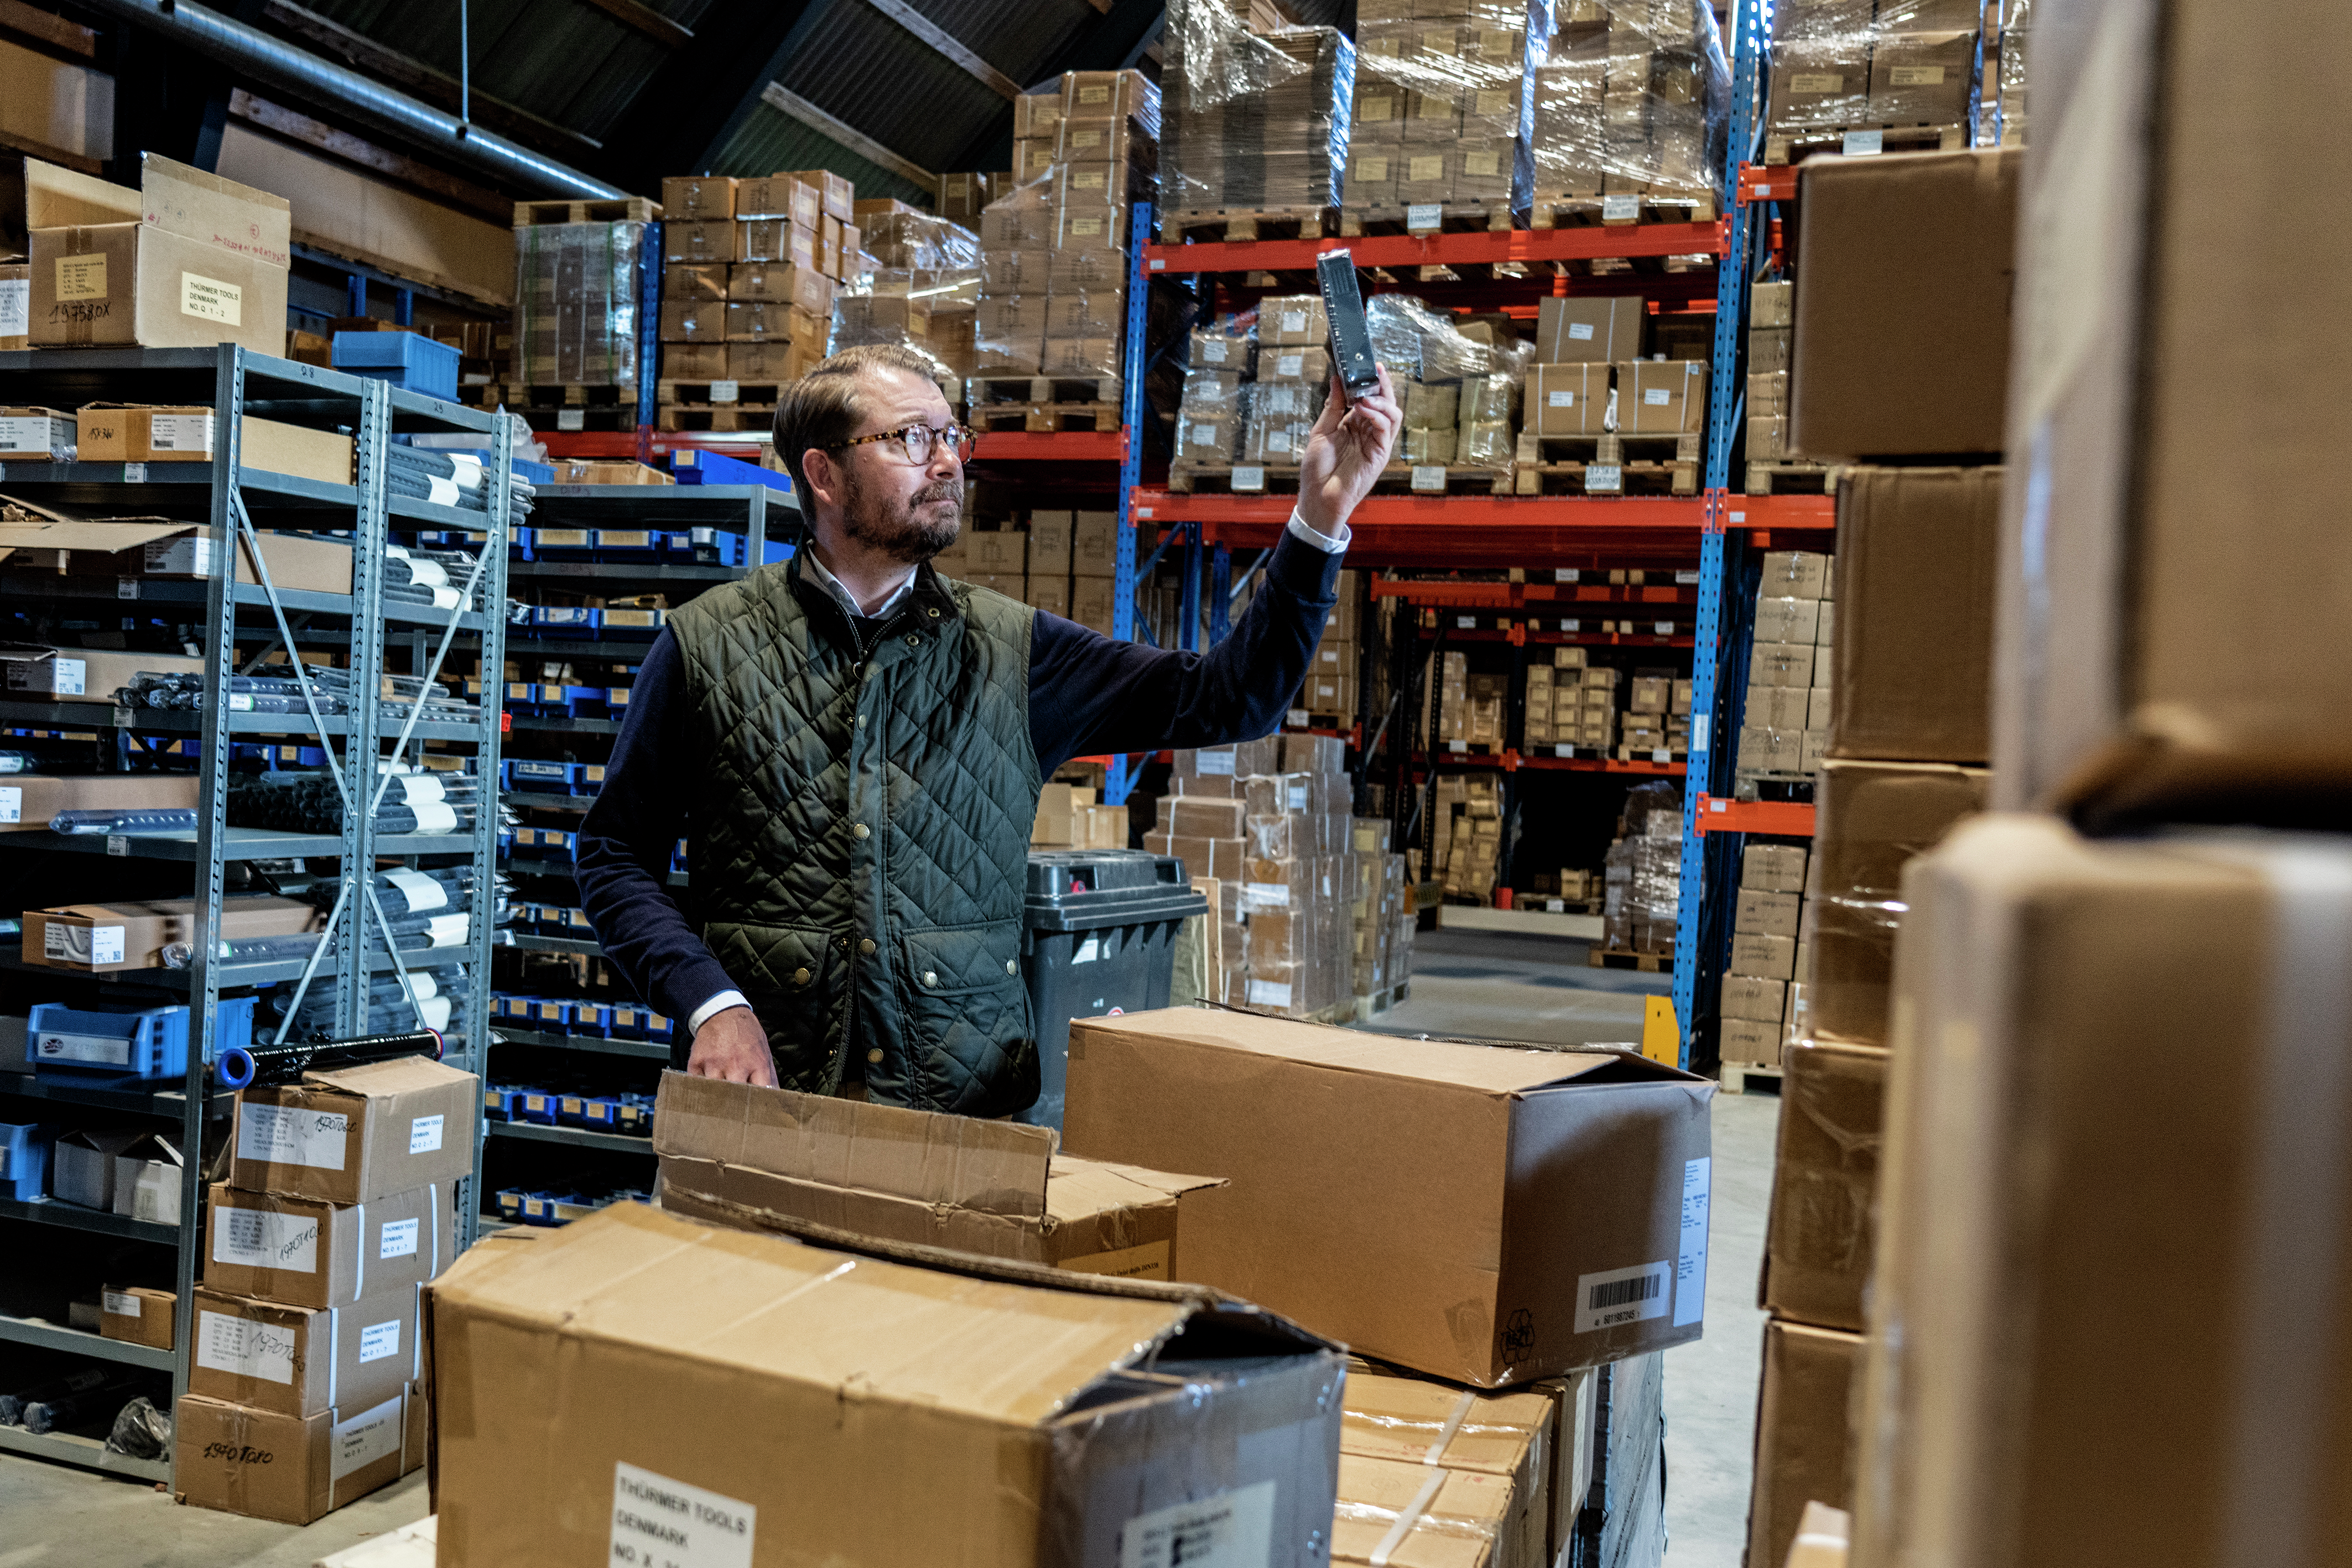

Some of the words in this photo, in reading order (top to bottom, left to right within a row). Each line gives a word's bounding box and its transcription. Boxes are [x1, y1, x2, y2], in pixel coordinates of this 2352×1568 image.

[190, 282, 218, 295] THÜRMER
[220, 289, 238, 300] TOOLS
[189, 292, 218, 305] DENMARK
[301, 366, 314, 378] 28
[434, 402, 444, 413] 29
[363, 1338, 383, 1347] DENMARK
[620, 1476, 691, 1514] THÜRMER
[695, 1501, 747, 1536] TOOLS
[617, 1509, 690, 1550] DENMARK
